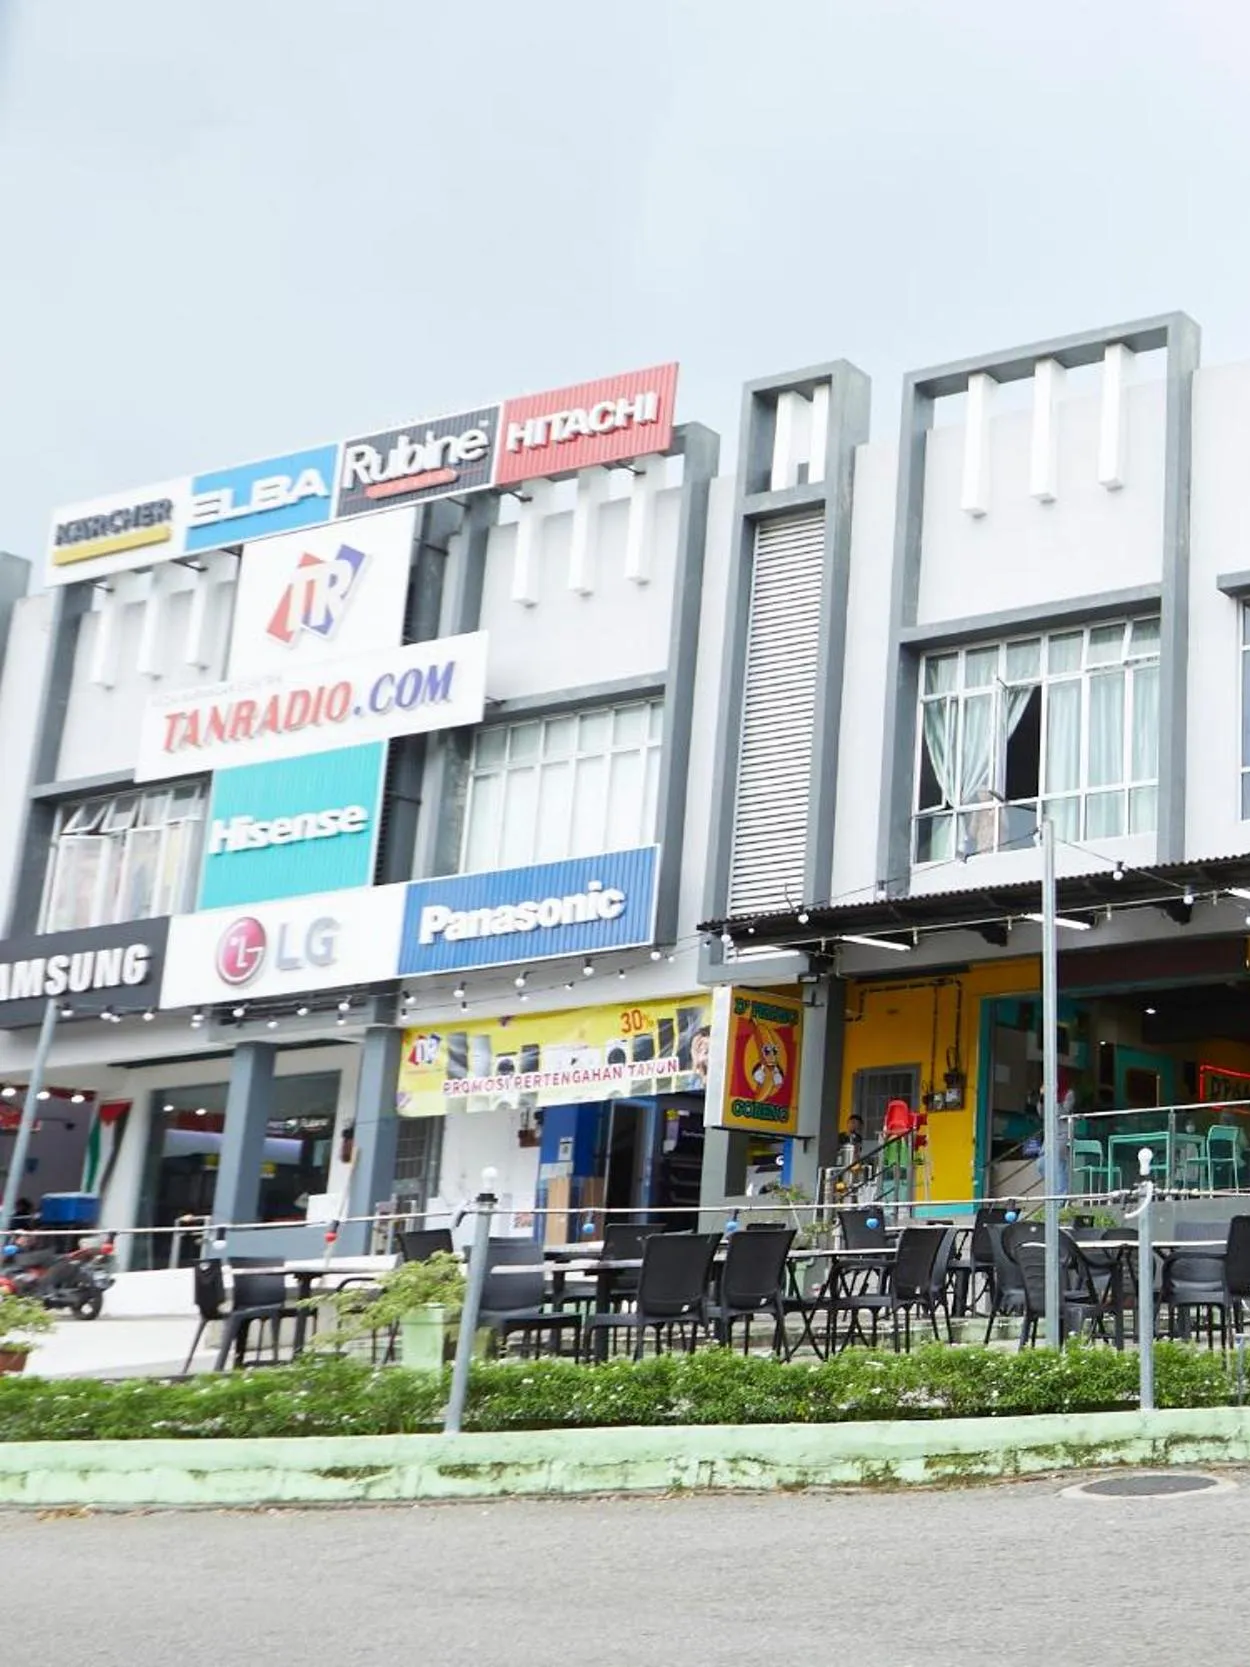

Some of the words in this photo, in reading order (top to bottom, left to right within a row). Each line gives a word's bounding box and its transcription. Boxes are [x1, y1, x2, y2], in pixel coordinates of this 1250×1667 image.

[506, 391, 660, 453] HITACHI
[342, 426, 489, 489] Rubine
[190, 468, 331, 528] ELBA
[163, 661, 456, 754] TANRADIO.COM
[208, 805, 369, 856] Hisense
[418, 880, 626, 945] Panasonic
[275, 916, 342, 971] LG
[514, 1066, 624, 1089] PERTENGAHAN
[627, 1057, 678, 1077] TAHUN
